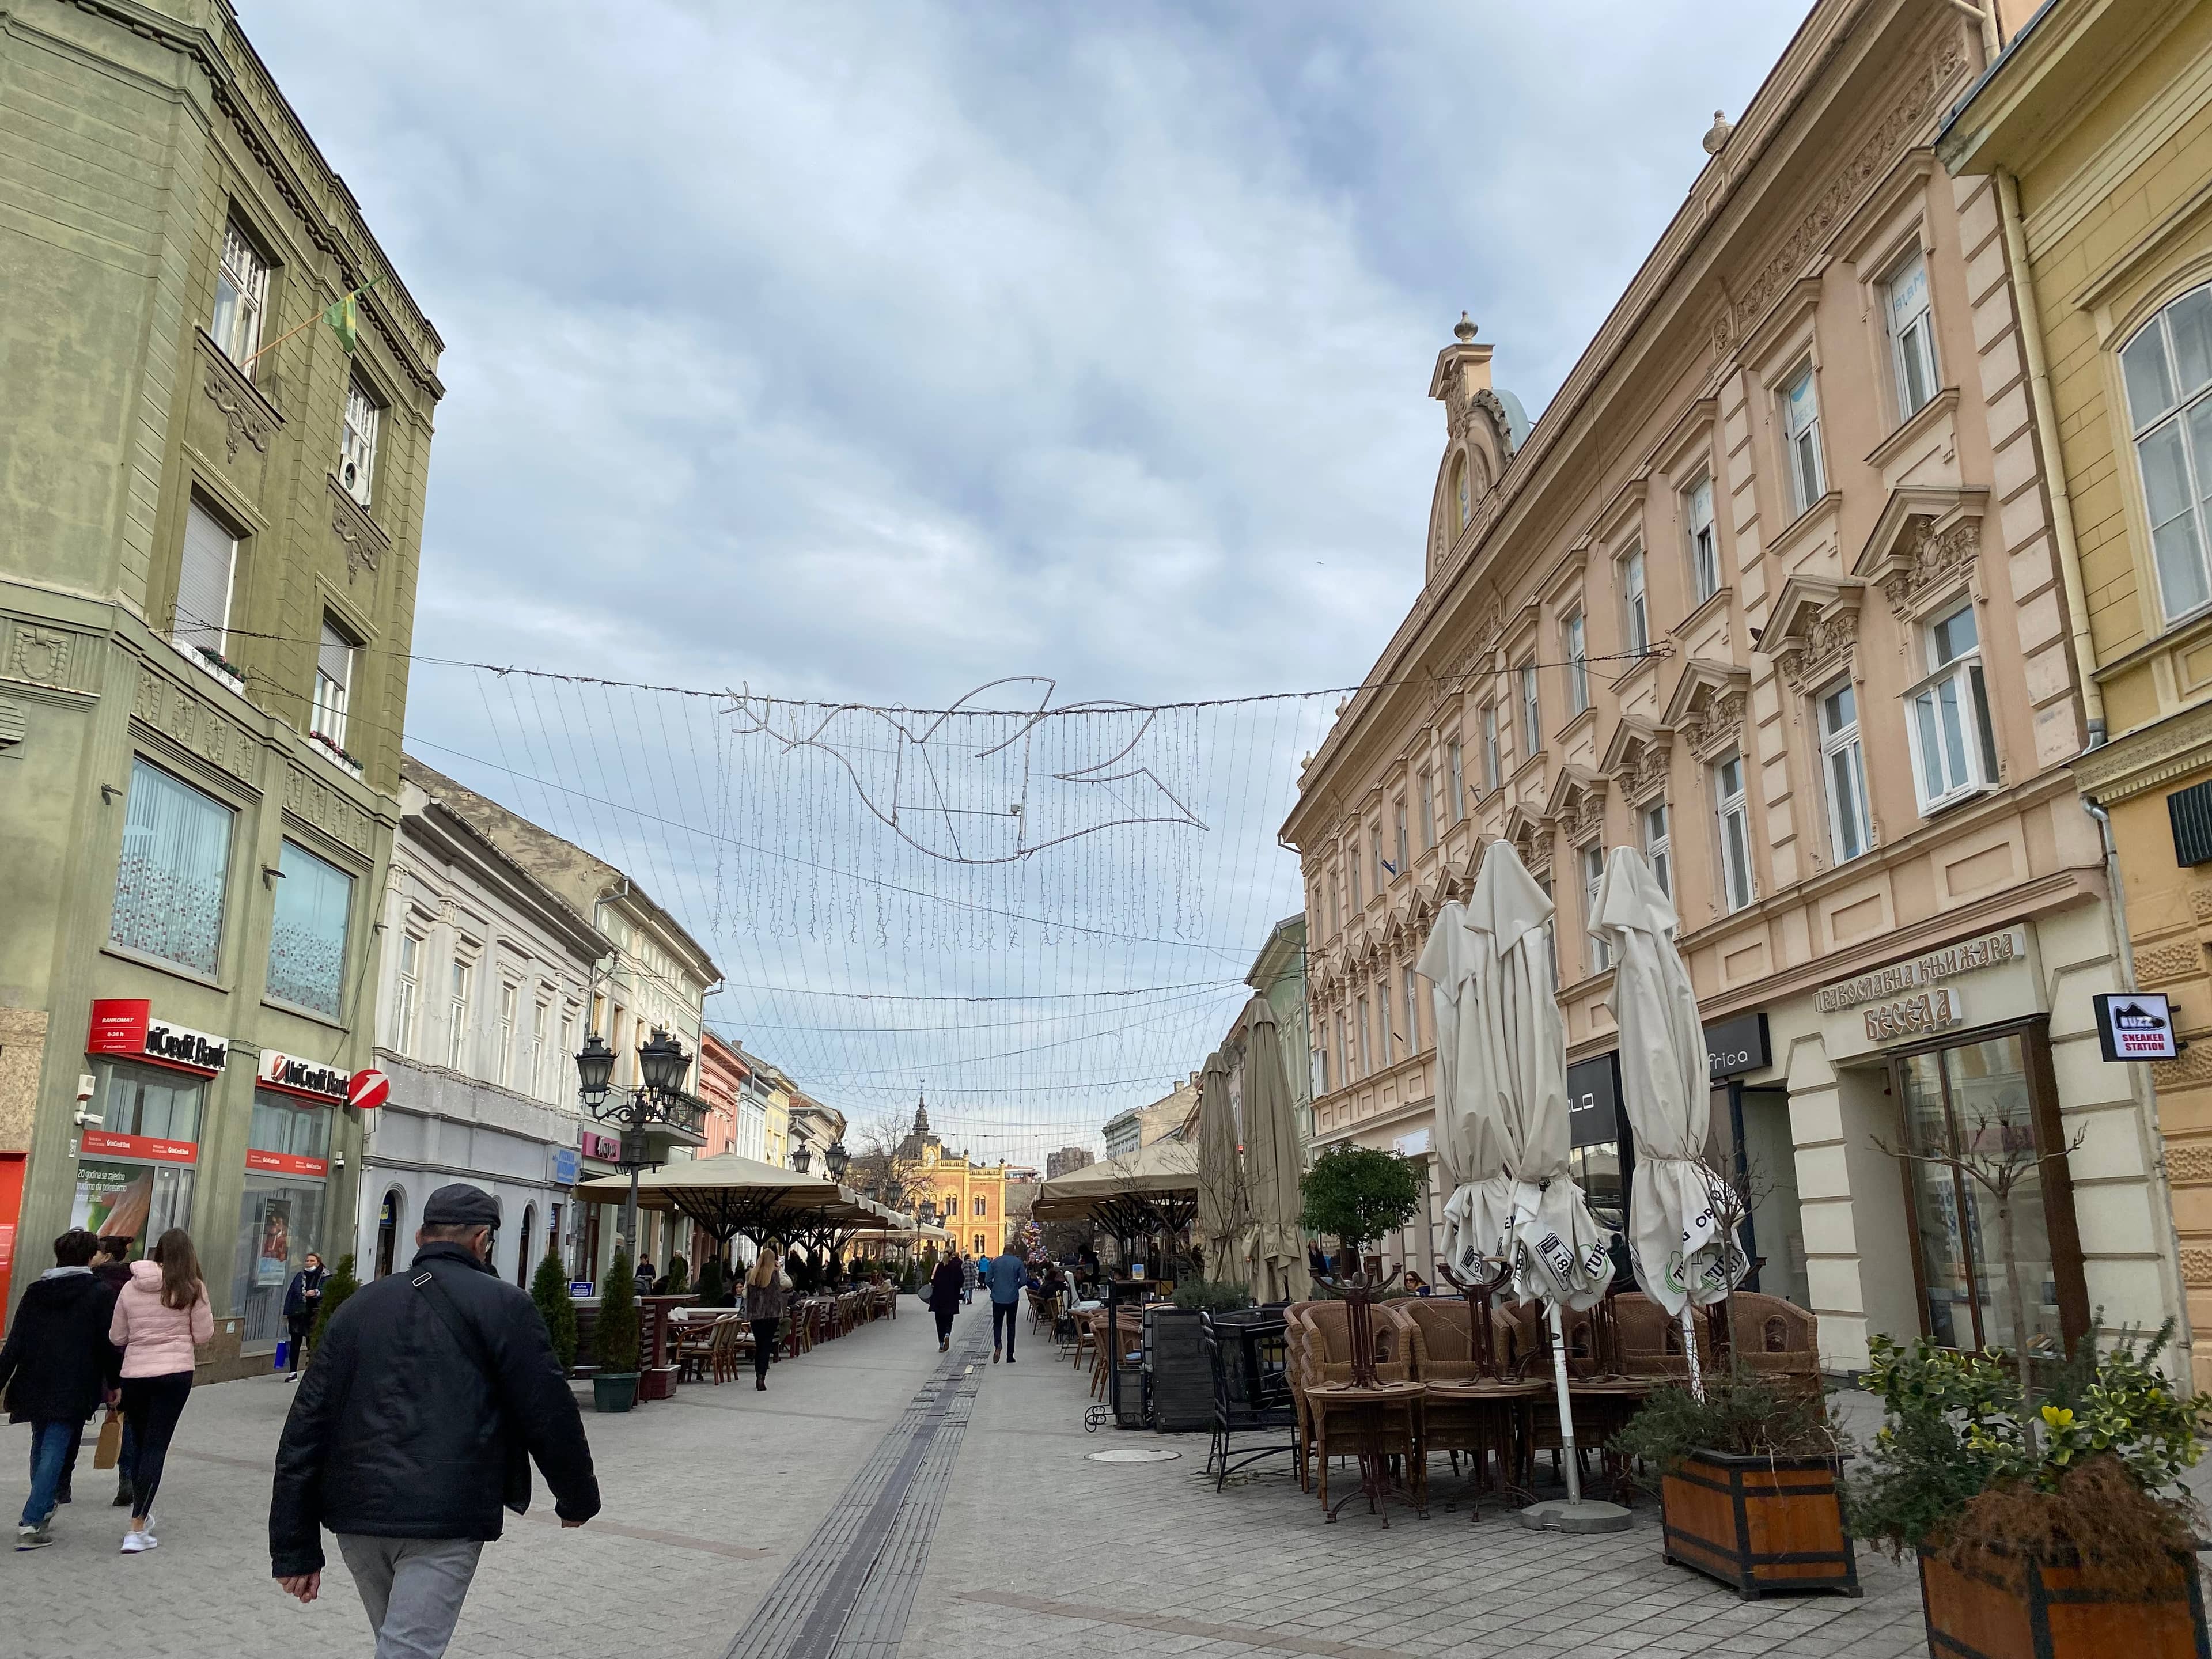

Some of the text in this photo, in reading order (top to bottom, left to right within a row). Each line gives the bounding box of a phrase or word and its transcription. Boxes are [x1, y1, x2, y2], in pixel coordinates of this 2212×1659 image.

[1812, 933, 2014, 1012] ПРАВОСЛАВНА КЊИЖАРА
[1863, 988, 1952, 1041] БЕСЕДА
[2120, 1016, 2153, 1028] BUZZ
[146, 1024, 227, 1069] niCredit Bank
[2122, 1033, 2165, 1041] SNEAKER
[2125, 1043, 2165, 1051] STATION
[285, 1060, 350, 1097] UniCredit Bank
[78, 1169, 85, 1178] 20
[85, 1170, 101, 1180] godina
[108, 1171, 125, 1181] zajedno
[96, 1181, 101, 1191] da
[1585, 1238, 1607, 1277] TUB
